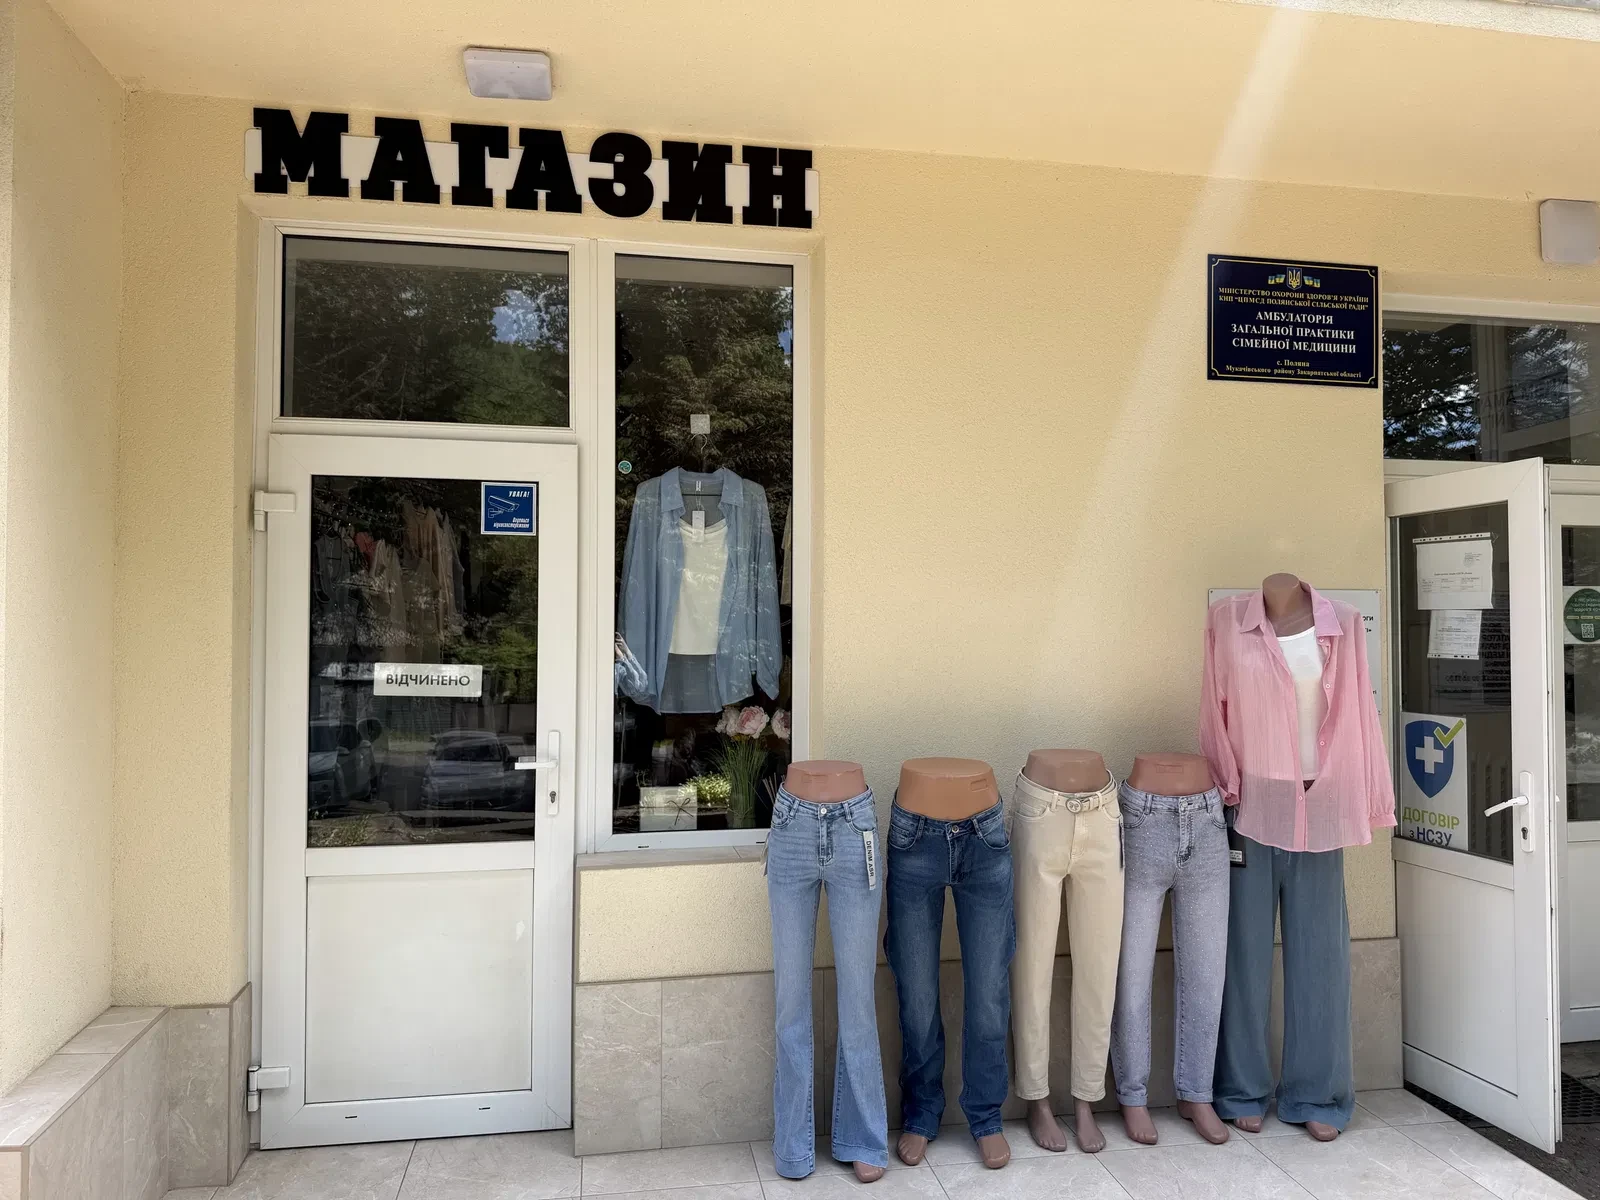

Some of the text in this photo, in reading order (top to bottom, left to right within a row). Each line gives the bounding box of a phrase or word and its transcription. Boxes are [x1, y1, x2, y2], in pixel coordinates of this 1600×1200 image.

[253, 107, 813, 229] МАГАЗИН
[1218, 287, 1270, 297] МІНІСТЕРСТВО
[1271, 290, 1306, 299] ОХОРОНИ
[1339, 294, 1369, 303] УКРАЇНИ
[1266, 298, 1311, 307] ПОЛЯНСЬКОЇ
[1311, 300, 1348, 309] СІЛЬСЬКОЇ
[1255, 311, 1333, 325] АМБУЛАТОРІЯ
[1231, 323, 1355, 340] ЗАГАЛЬНОЇ ПРАКТИКИ
[1232, 337, 1356, 354] СІМЕЙНОЇ МЕДИЦИНИ
[1225, 364, 1361, 378] Мукачівського району Закарпатської області
[1284, 359, 1310, 368] Поляна
[386, 674, 471, 687] ВІДЧИНЕНО
[1401, 806, 1460, 829] ДОГОВІР
[1417, 827, 1453, 846] НСЗУ
